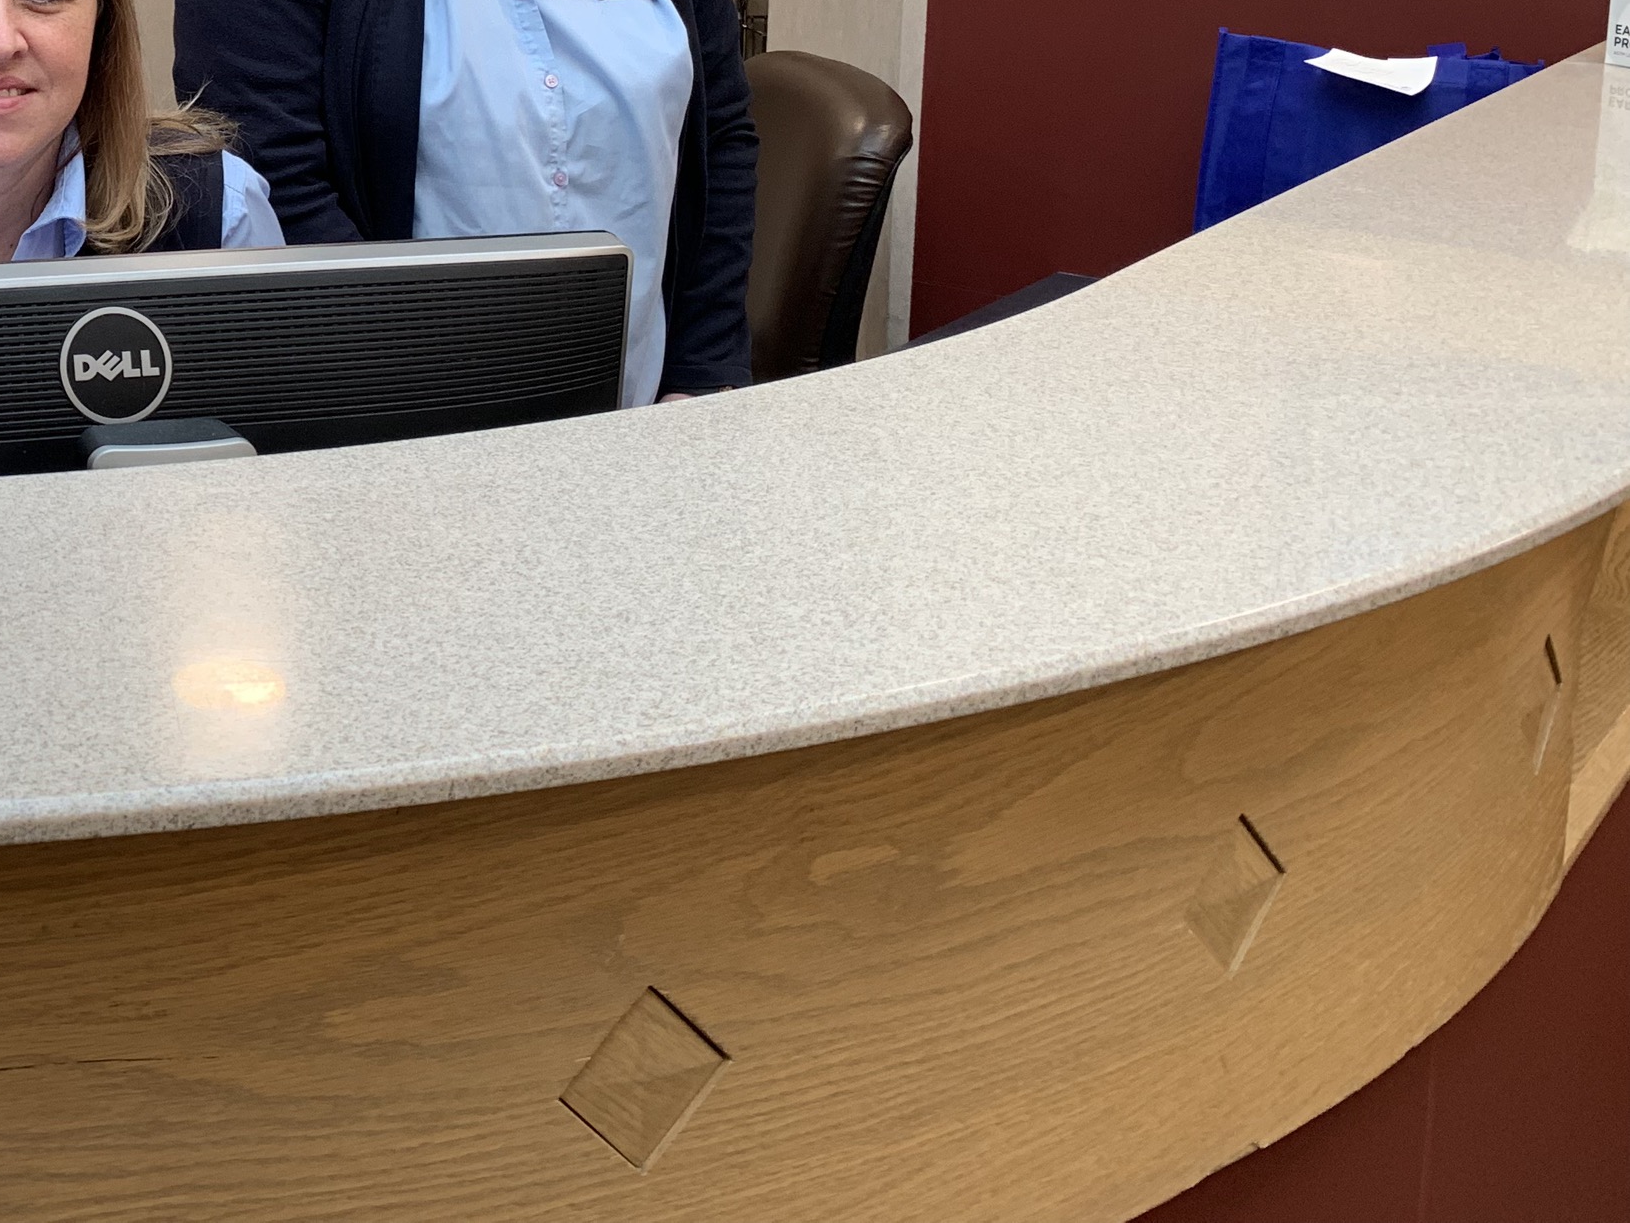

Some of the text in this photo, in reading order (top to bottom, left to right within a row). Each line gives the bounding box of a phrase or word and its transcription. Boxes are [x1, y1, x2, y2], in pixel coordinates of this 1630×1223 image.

[1615, 24, 1630, 36] EA
[1614, 36, 1630, 49] PR
[73, 349, 160, 382] DELL
